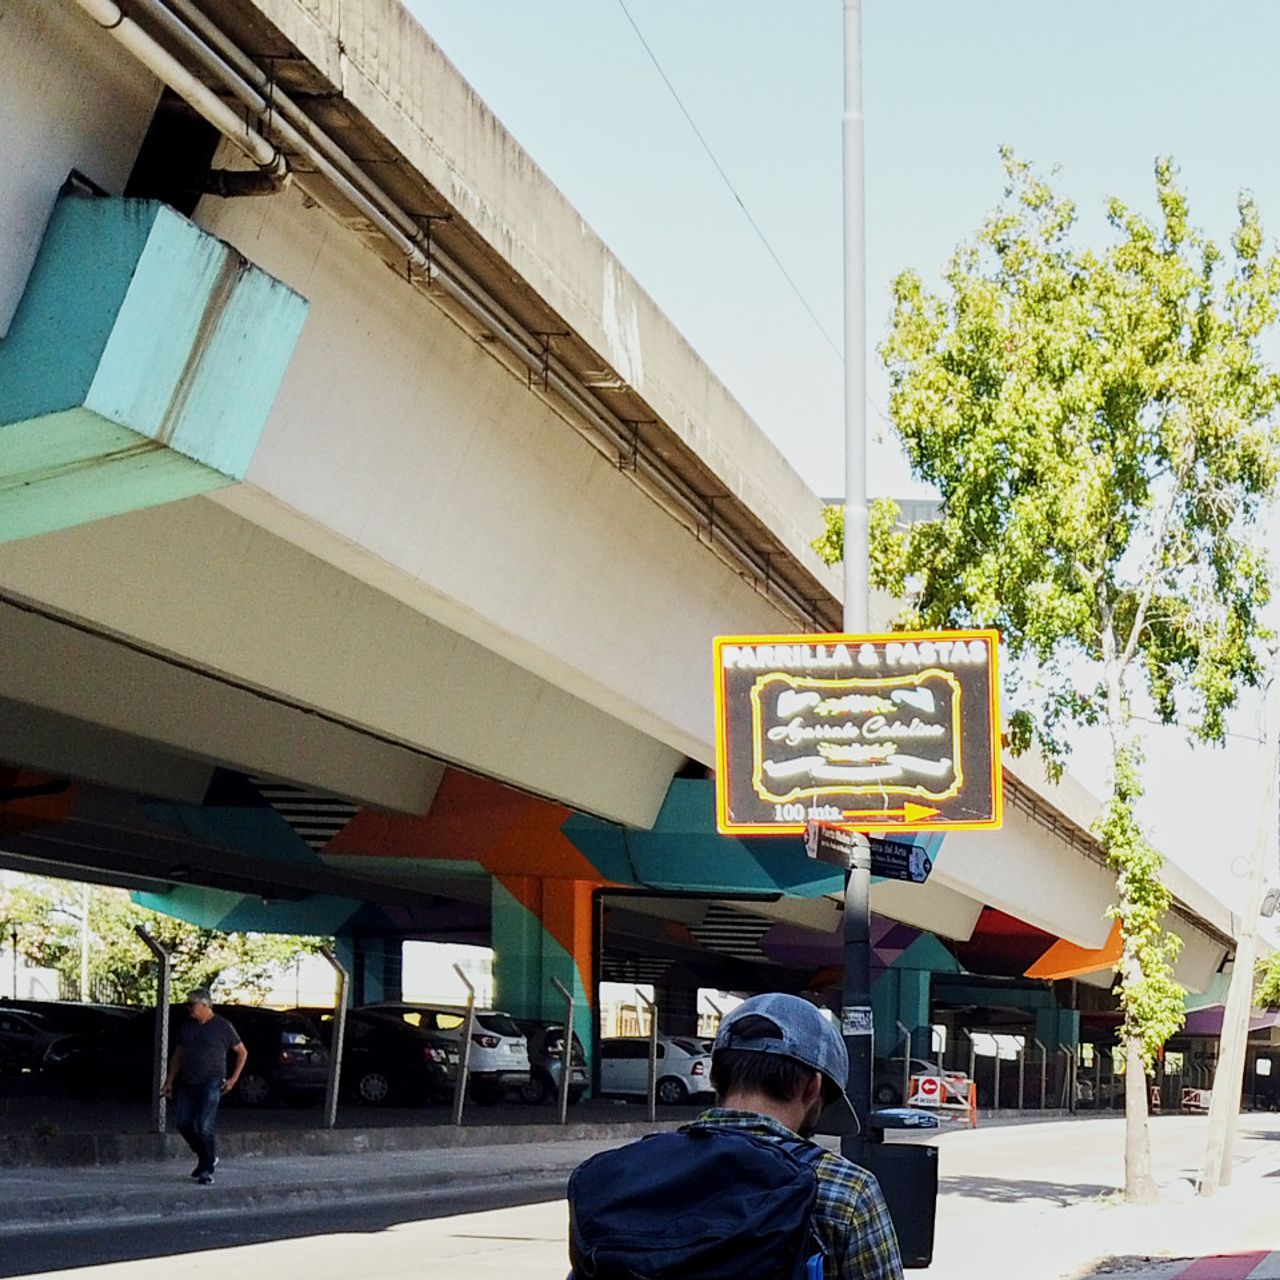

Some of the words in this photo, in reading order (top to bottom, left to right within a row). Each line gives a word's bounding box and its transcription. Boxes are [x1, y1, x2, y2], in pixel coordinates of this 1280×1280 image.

[723, 643, 853, 669] PARRILLA
[857, 642, 880, 666] &
[885, 639, 988, 666] PASTAS
[774, 802, 805, 822] 100
